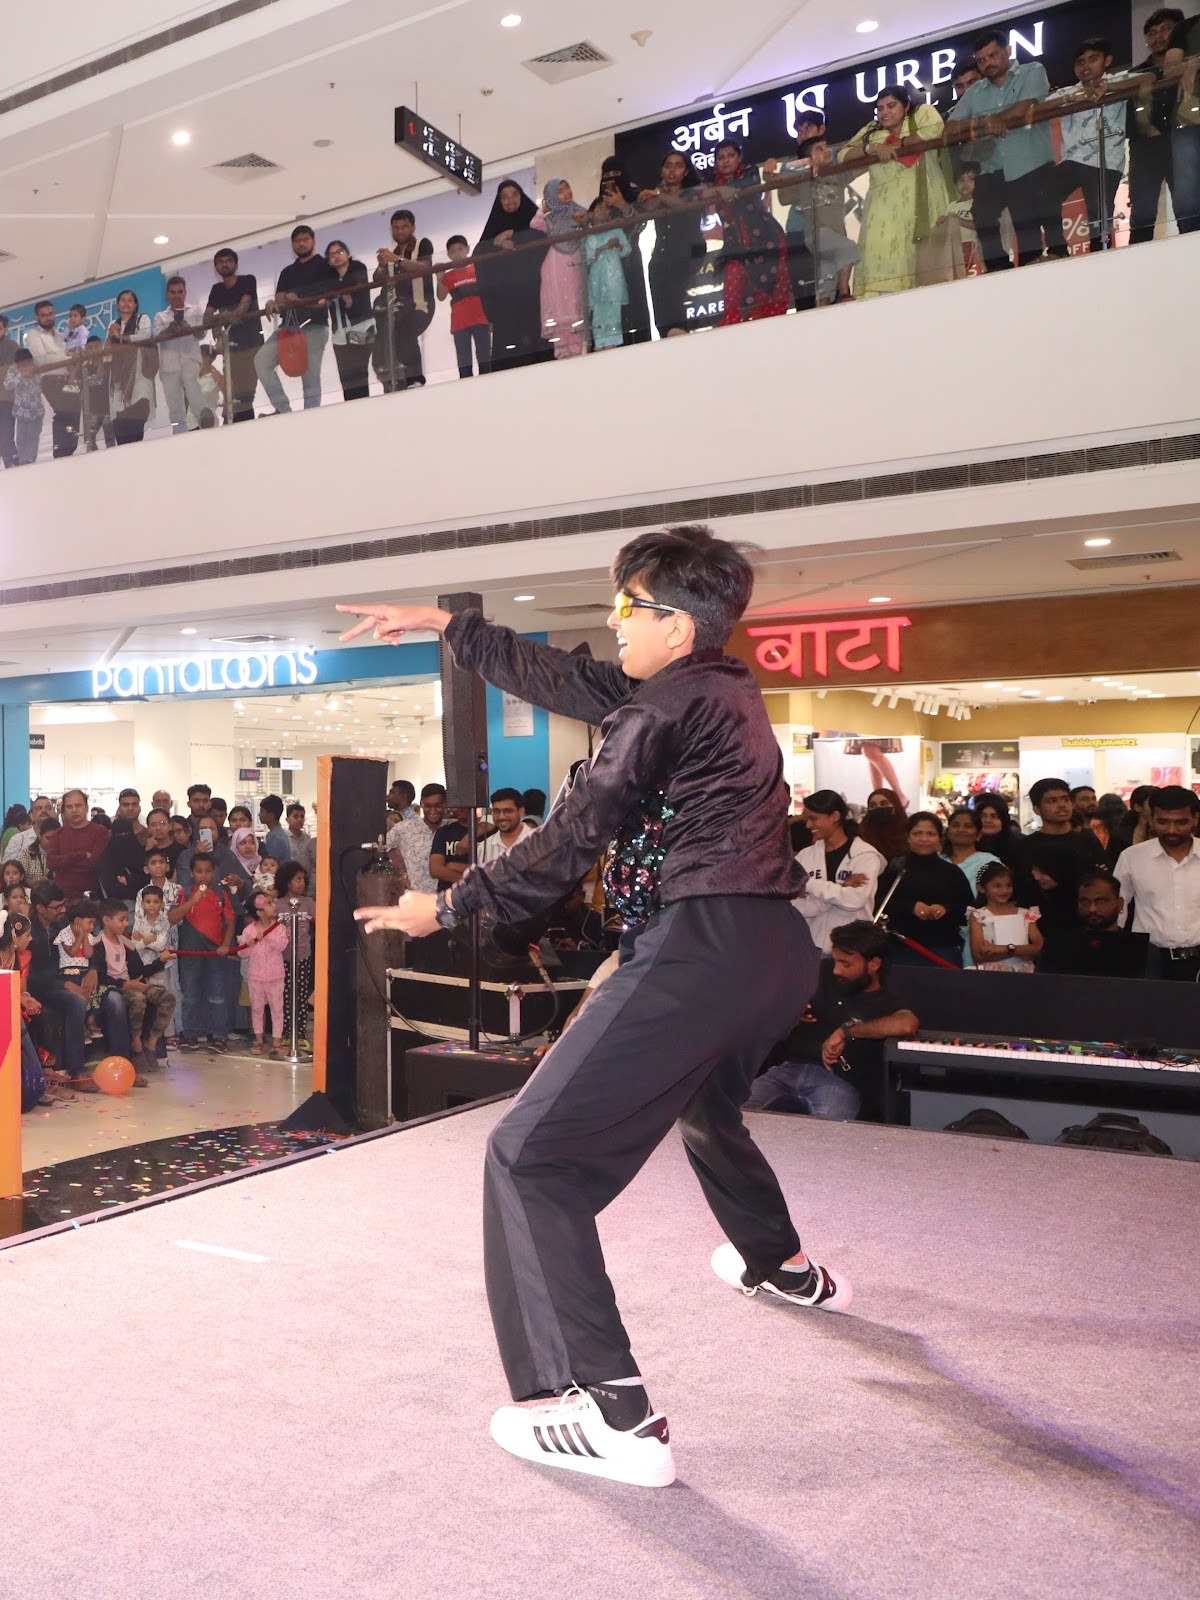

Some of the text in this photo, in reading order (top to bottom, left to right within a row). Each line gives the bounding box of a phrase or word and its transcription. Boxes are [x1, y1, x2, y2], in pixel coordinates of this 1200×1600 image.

[855, 21, 1044, 103] URBN
[671, 103, 752, 152] अर्बन
[746, 616, 912, 678] बाटा
